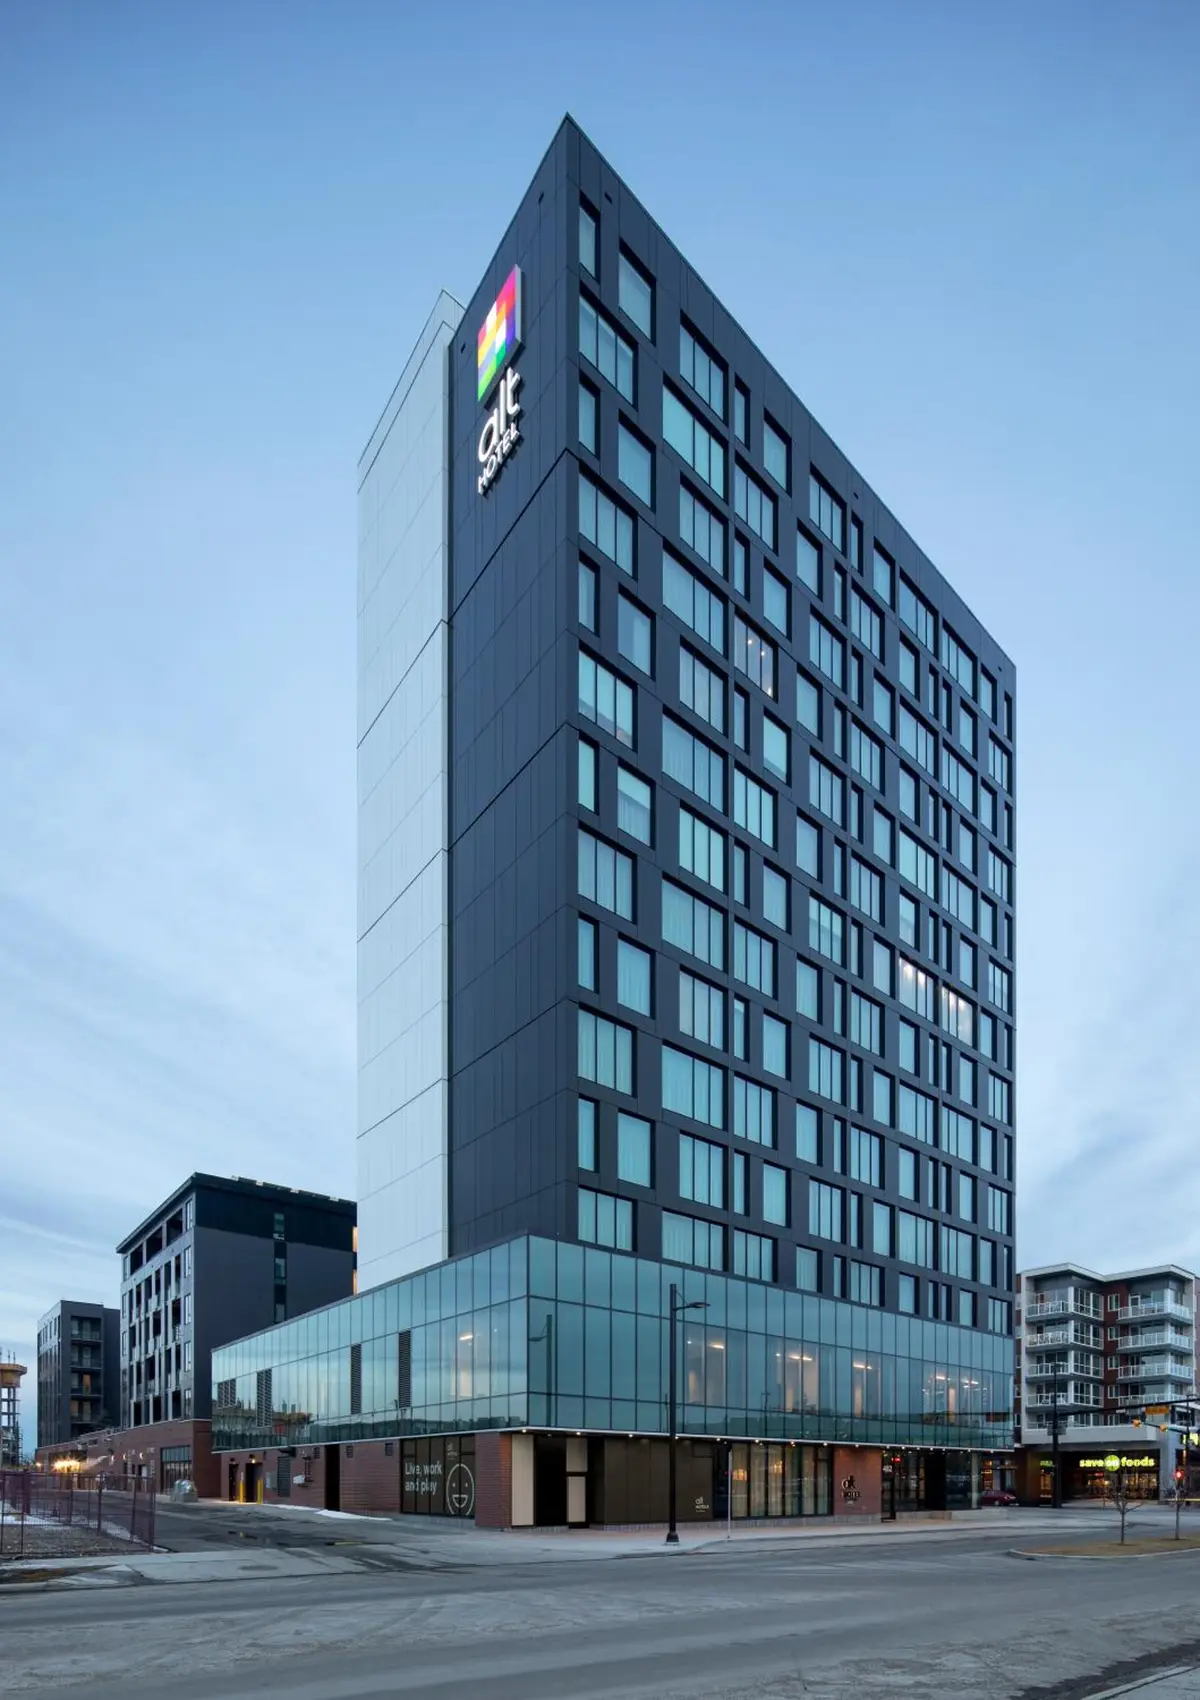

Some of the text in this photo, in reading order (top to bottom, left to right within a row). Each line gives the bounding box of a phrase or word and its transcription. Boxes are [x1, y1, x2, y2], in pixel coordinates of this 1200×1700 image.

[478, 367, 520, 462] alt
[478, 422, 520, 494] HOTEL
[423, 1460, 442, 1475] work
[1079, 1459, 1104, 1467] save
[1121, 1456, 1155, 1467] foods
